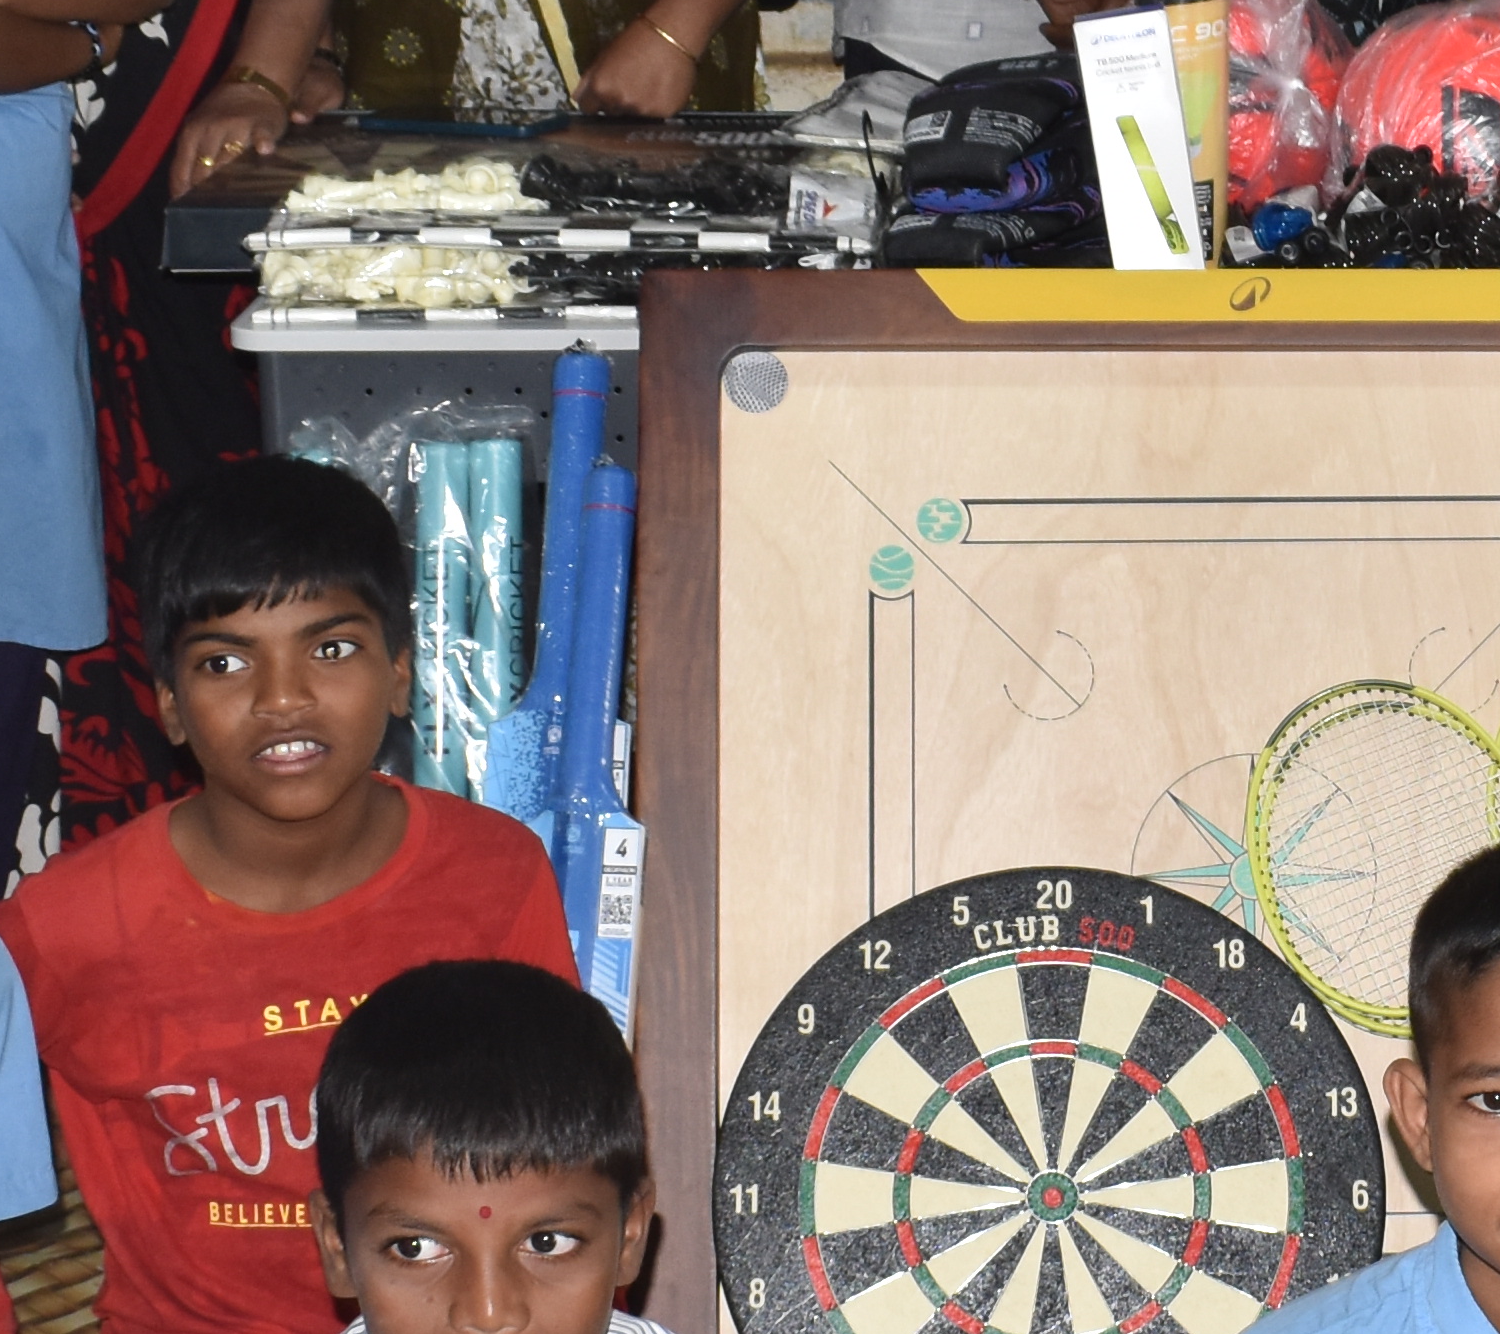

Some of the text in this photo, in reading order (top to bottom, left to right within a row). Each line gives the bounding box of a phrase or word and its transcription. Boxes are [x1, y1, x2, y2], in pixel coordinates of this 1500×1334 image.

[615, 837, 628, 857] 4
[1035, 880, 1073, 909] 20
[952, 896, 971, 927] 5
[1139, 897, 1154, 925] 1
[973, 914, 1136, 951] CLUB 500
[859, 941, 891, 970] 12
[1213, 940, 1245, 969] 18
[262, 993, 369, 1032] STAY
[797, 1004, 815, 1034] 9
[1289, 1004, 1308, 1032] 4
[748, 1091, 781, 1120] 14
[1325, 1089, 1358, 1117] 13
[729, 1185, 759, 1213] 11
[1351, 1180, 1370, 1210] 6
[209, 1201, 306, 1226] BELIEVE
[747, 1278, 766, 1309] 8
